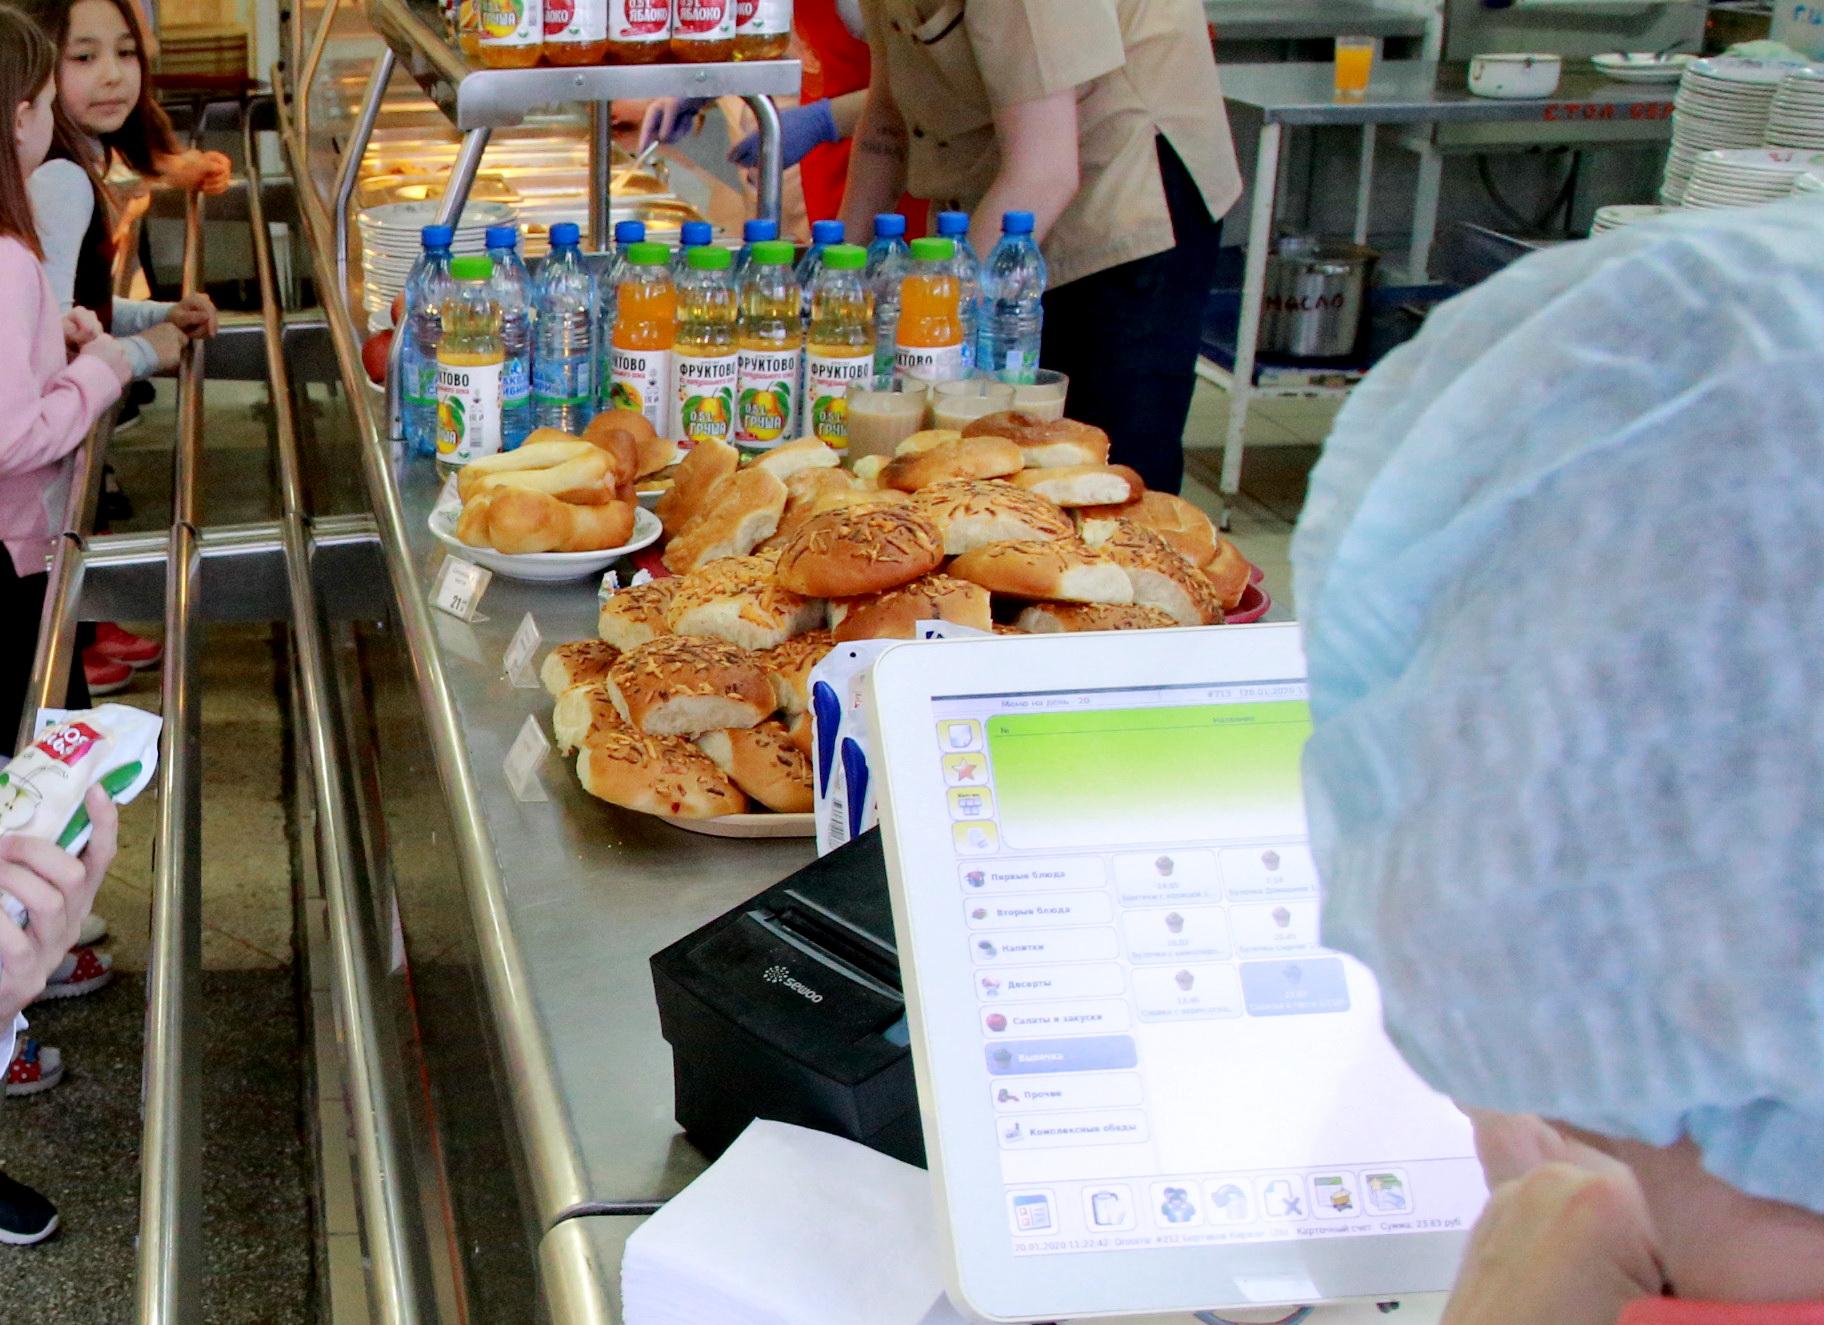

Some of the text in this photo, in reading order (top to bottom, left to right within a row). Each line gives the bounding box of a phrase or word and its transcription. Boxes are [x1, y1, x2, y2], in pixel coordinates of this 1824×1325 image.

[629, 7, 668, 22] ЯБЛОКО
[679, 6, 721, 21] ЯБЛОКО
[680, 361, 736, 378] ФРУКТОВО
[738, 356, 795, 372] ФРУКТОВО
[811, 363, 869, 379] ФРУКТОВО
[689, 421, 727, 436] ГРУША
[745, 414, 782, 429] ГРУША
[819, 421, 849, 436] ГРУШ
[991, 871, 1066, 883] Первые блюда
[996, 906, 1071, 918] Вторые блюда
[1002, 943, 1045, 952] Напитки
[783, 977, 824, 1004] sewoo
[1008, 979, 1052, 990] Десерты
[1012, 1016, 1051, 1025] Салаты
[1029, 1125, 1101, 1137] Комплексные
